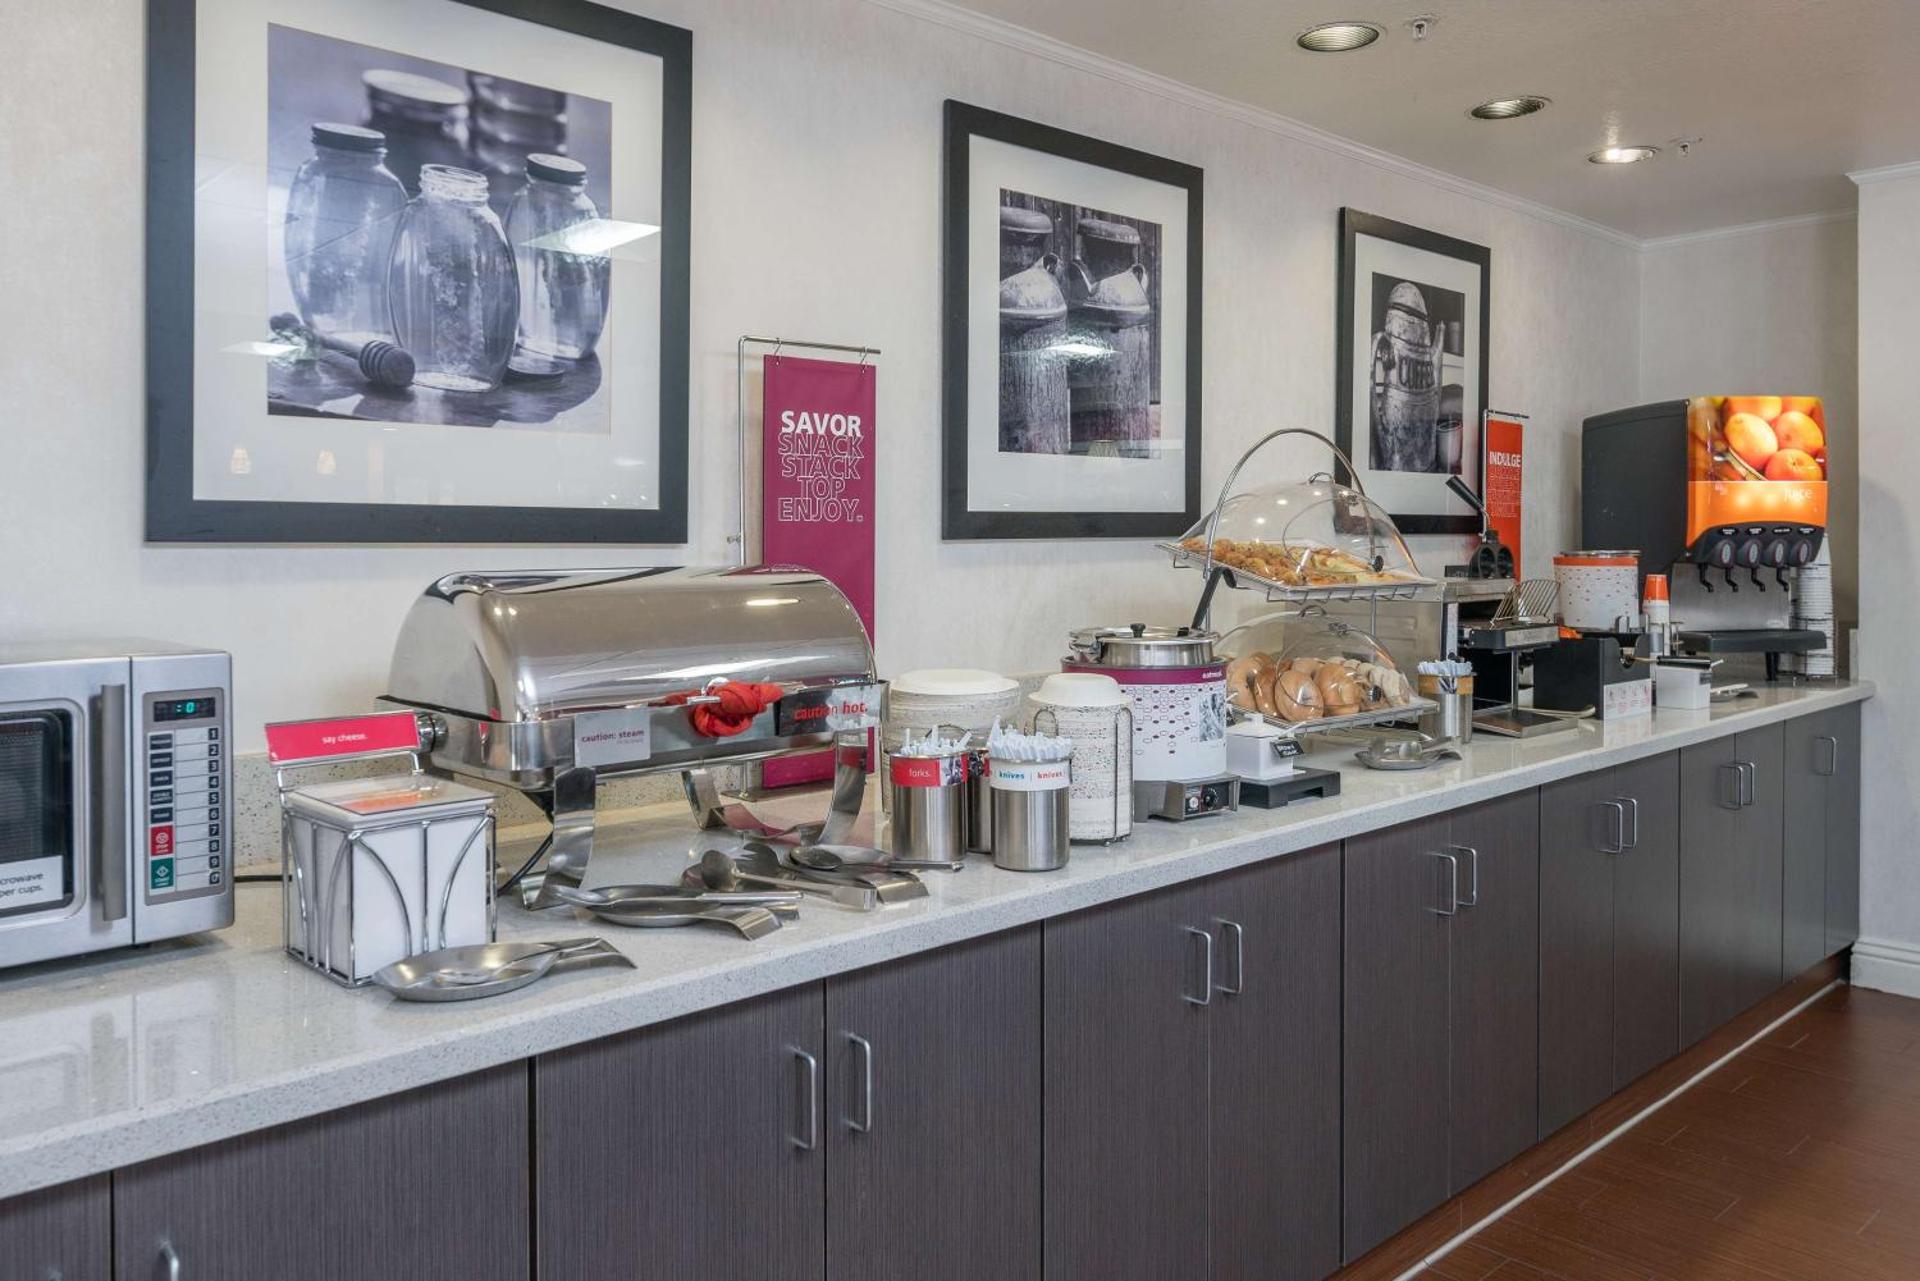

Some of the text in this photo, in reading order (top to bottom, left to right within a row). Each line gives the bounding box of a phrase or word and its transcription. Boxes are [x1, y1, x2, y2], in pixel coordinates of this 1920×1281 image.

[781, 411, 861, 437] SAVOR
[778, 432, 864, 458] SNACK
[781, 454, 860, 479] STACK
[1489, 451, 1521, 467] INDULGE
[797, 476, 845, 500] TOP
[778, 498, 863, 522] ENJOY.
[794, 704, 838, 721] caution
[322, 736, 336, 745] say
[581, 732, 617, 743] caution:
[619, 730, 645, 739] steam
[999, 771, 1025, 780] knives
